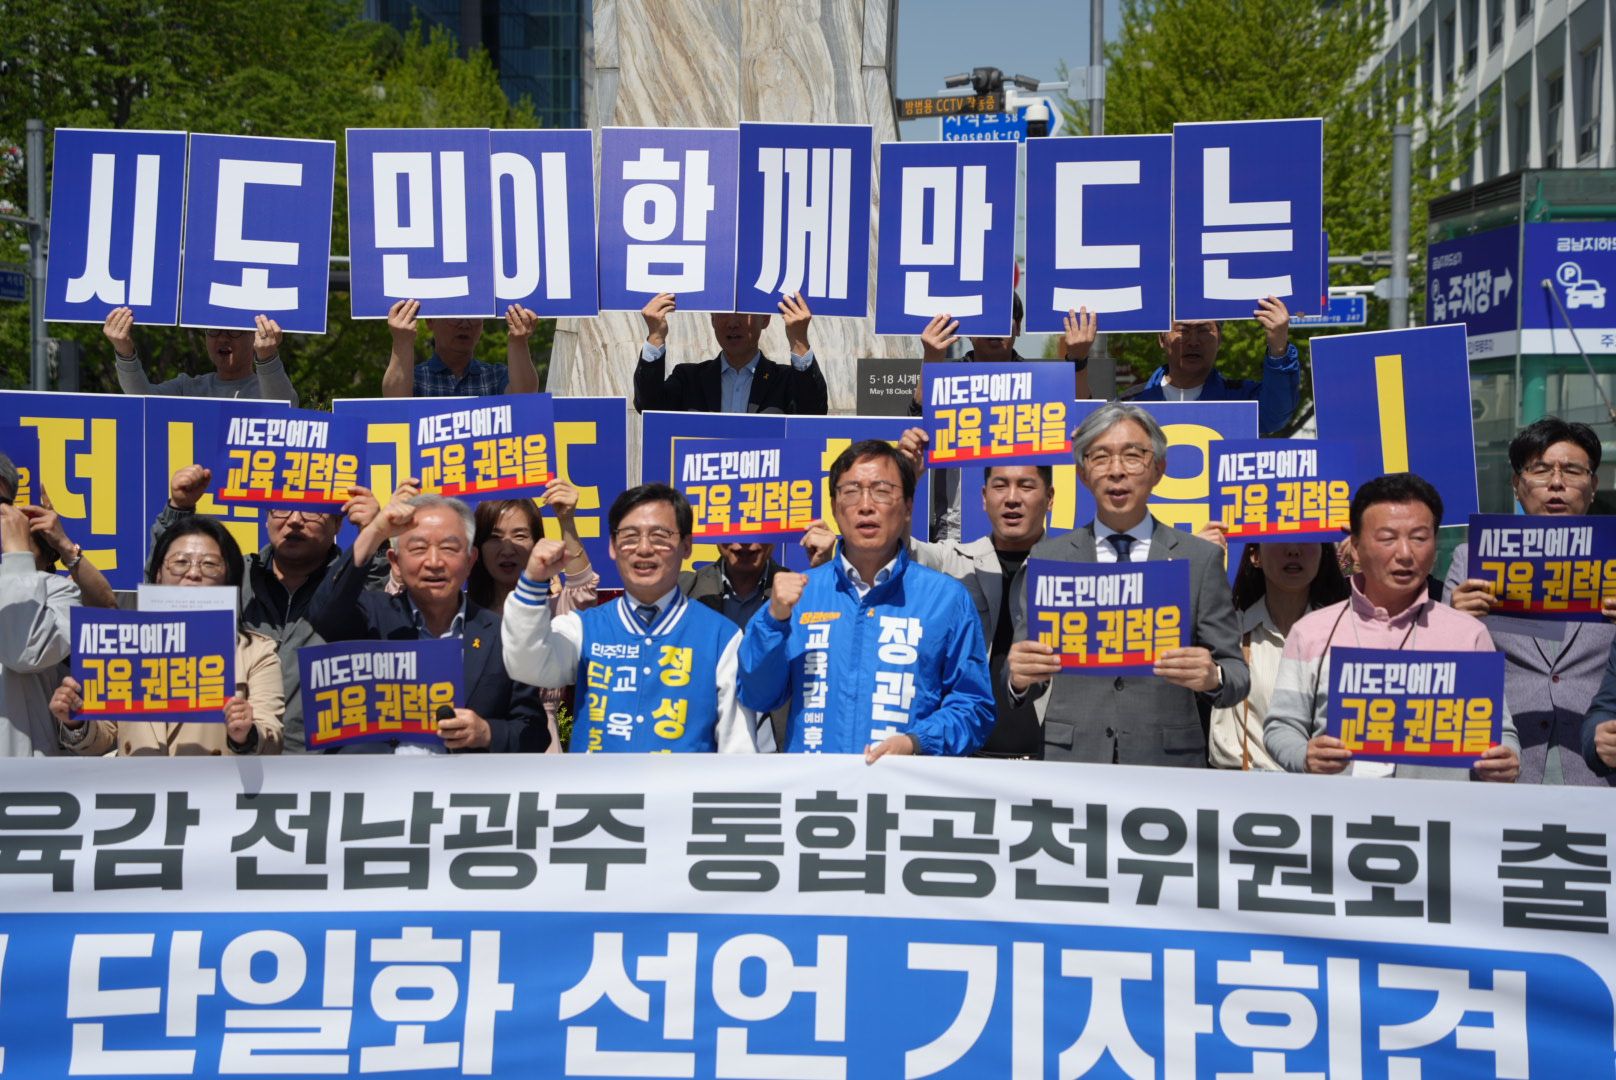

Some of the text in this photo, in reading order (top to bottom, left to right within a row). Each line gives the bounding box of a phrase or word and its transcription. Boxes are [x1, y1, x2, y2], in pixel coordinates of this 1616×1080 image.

[905, 100, 933, 115] 방범용
[936, 98, 963, 112] CCTV
[621, 147, 852, 300] 함께
[899, 147, 1294, 318] 만드는
[1449, 270, 1492, 319] 주차장
[870, 374, 894, 384] 5·18
[870, 388, 884, 396] May
[932, 372, 1032, 405] 시도민에게
[227, 418, 328, 448] 시도민에게
[418, 405, 511, 445] 시도민에게
[933, 404, 1065, 459] 교육 권력을
[224, 450, 358, 501] 교육 권력을
[420, 434, 547, 495] 교육 권력을
[682, 449, 780, 481] 시도민에게
[1217, 449, 1317, 482] 시도민에게
[690, 481, 812, 533] 교육 권력을
[1221, 481, 1350, 533] 교육 권력을
[1479, 527, 1592, 557] 시도민에게
[1035, 572, 1143, 607] 시도민에게
[79, 622, 186, 654] 시도민에게
[591, 642, 640, 660] 민주진보
[1039, 606, 1180, 663] 교육 권력을
[82, 656, 224, 710] 교육 권력을
[311, 651, 416, 688] 시도민에게
[1338, 662, 1456, 694] 시도민에게
[316, 683, 454, 740] 교육 권력을
[649, 645, 693, 754] 정성
[803, 726, 823, 754] 후
[1340, 699, 1492, 752] 교육 권력을
[0, 790, 1611, 934] 육감 전남광주 통합공천위원회 출
[67, 926, 515, 1076] 단일화
[559, 931, 847, 1080] 선언
[905, 940, 1529, 1080] 기자회견
